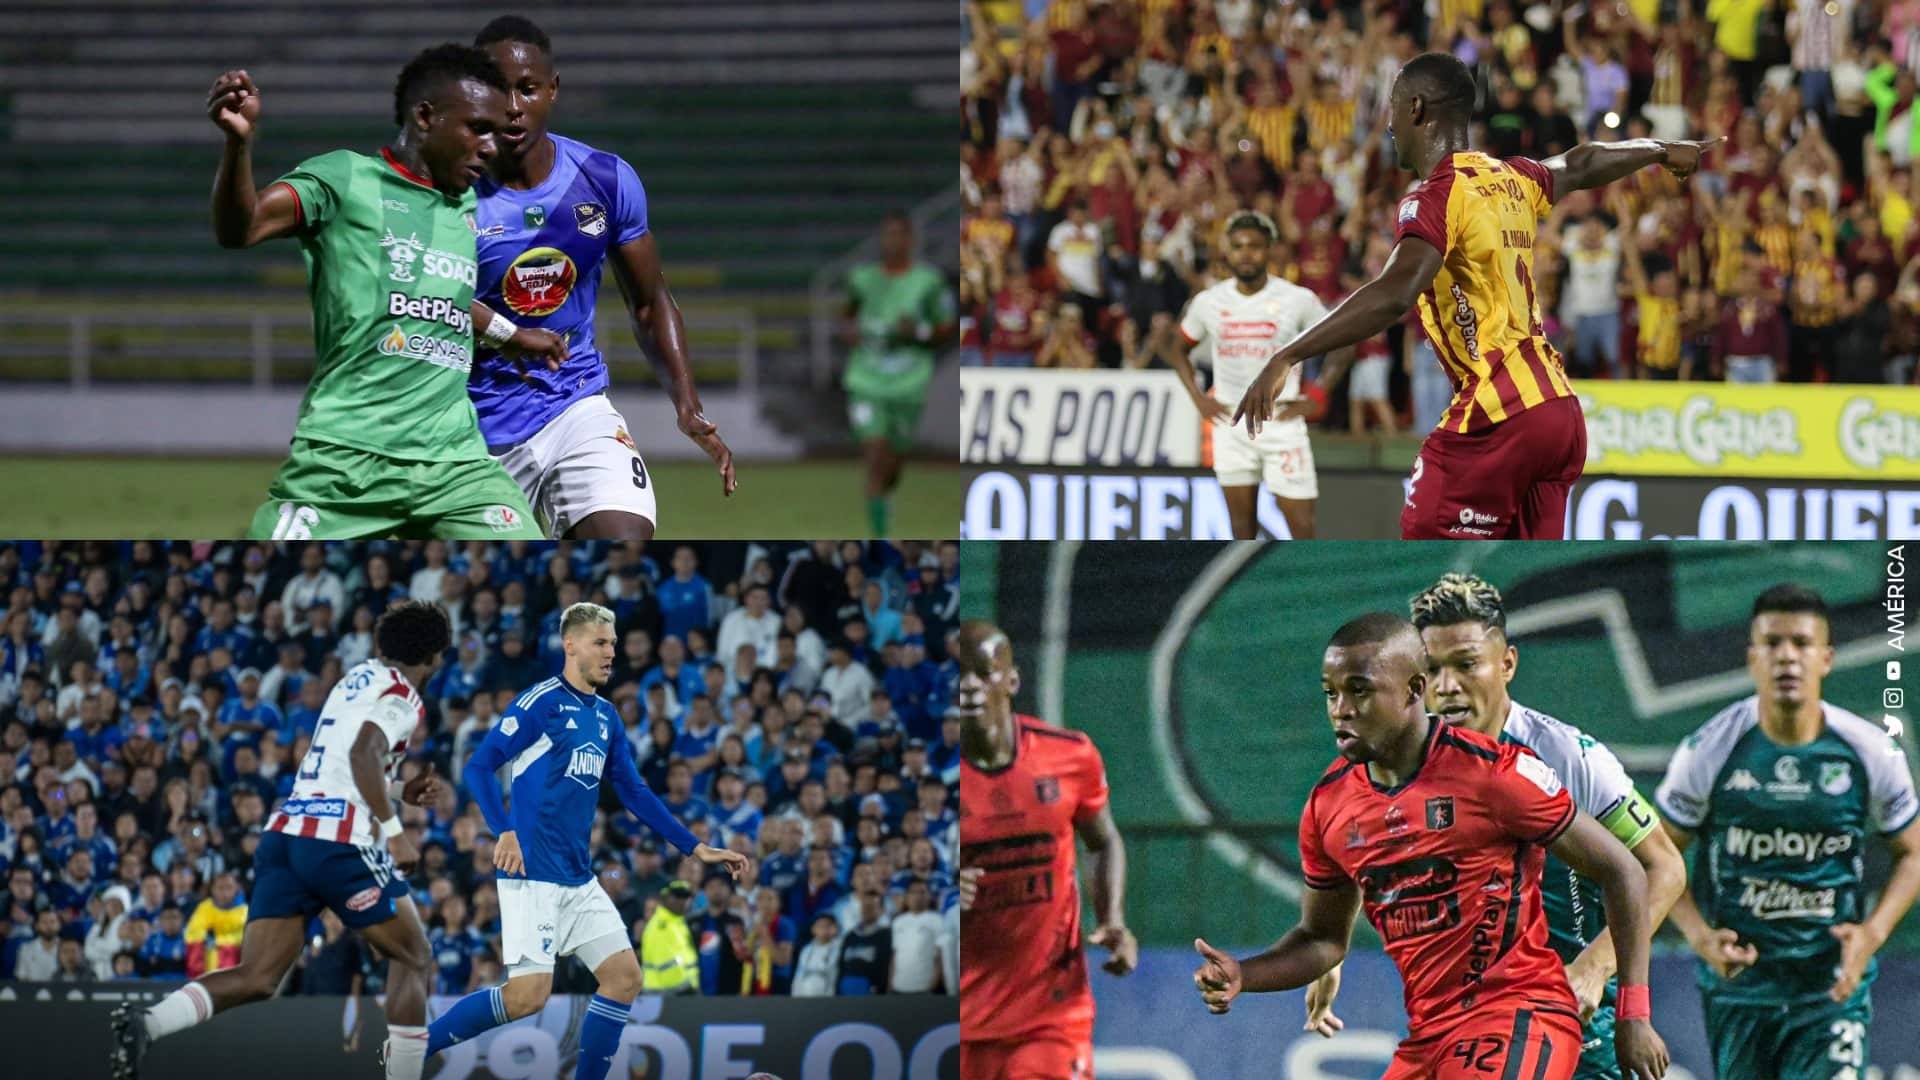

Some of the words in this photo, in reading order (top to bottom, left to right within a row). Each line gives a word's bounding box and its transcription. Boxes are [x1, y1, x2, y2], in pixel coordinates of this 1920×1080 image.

[960, 388, 1030, 462] AS
[1049, 388, 1173, 465] POOL
[631, 456, 647, 489] 9
[1627, 800, 1650, 828] C
[1455, 1037, 1505, 1073] 42
